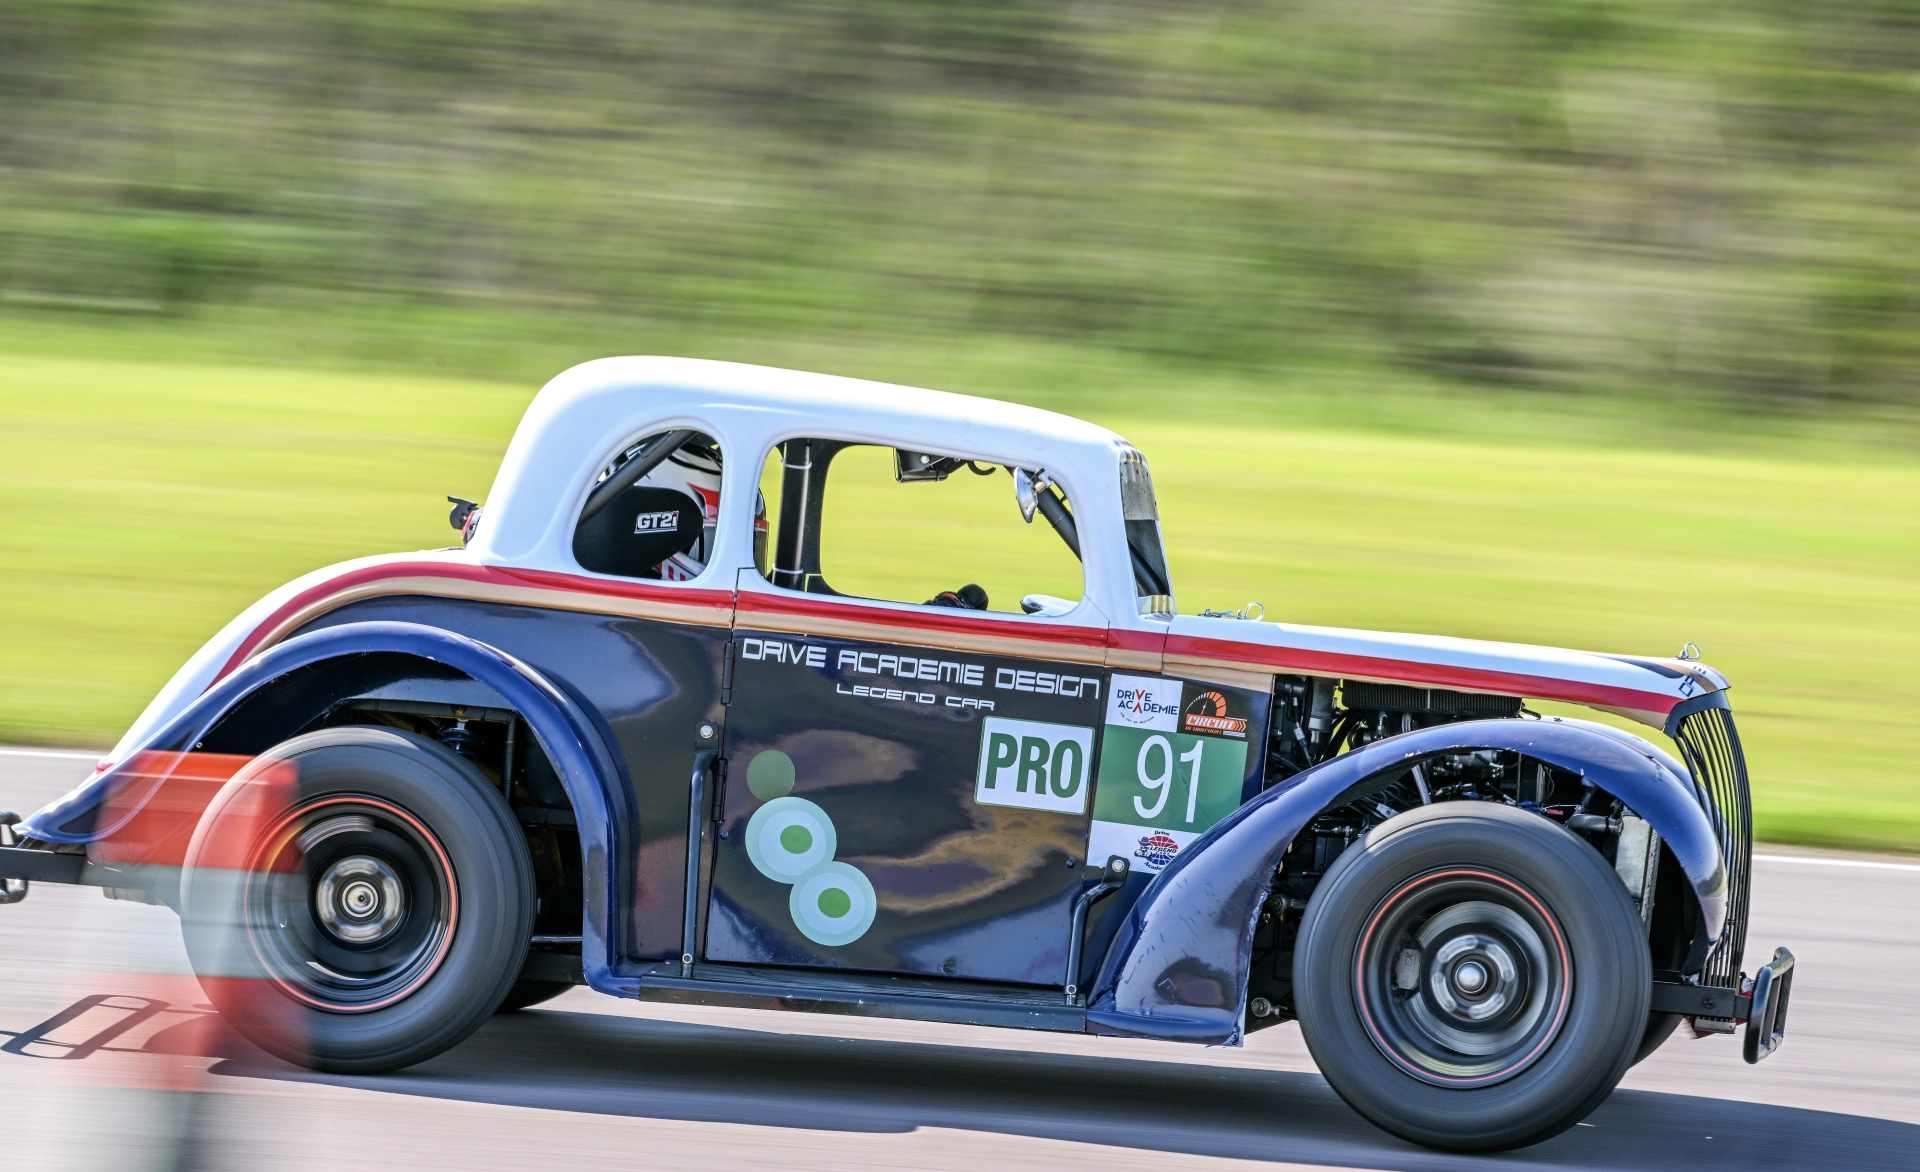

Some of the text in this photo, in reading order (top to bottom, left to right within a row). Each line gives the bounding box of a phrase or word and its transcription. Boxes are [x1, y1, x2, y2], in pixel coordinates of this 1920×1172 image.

[636, 510, 679, 530] GT2i
[742, 638, 1100, 699] DRIVE ACADEMIE DESIGN
[836, 684, 995, 711] LEGEND CAR
[1117, 689, 1152, 701] DRIVE
[1118, 700, 1179, 715] ACADEMIE
[1187, 715, 1234, 729] CIRCUIT
[984, 732, 1083, 799] PRO
[1133, 734, 1204, 823] 91
